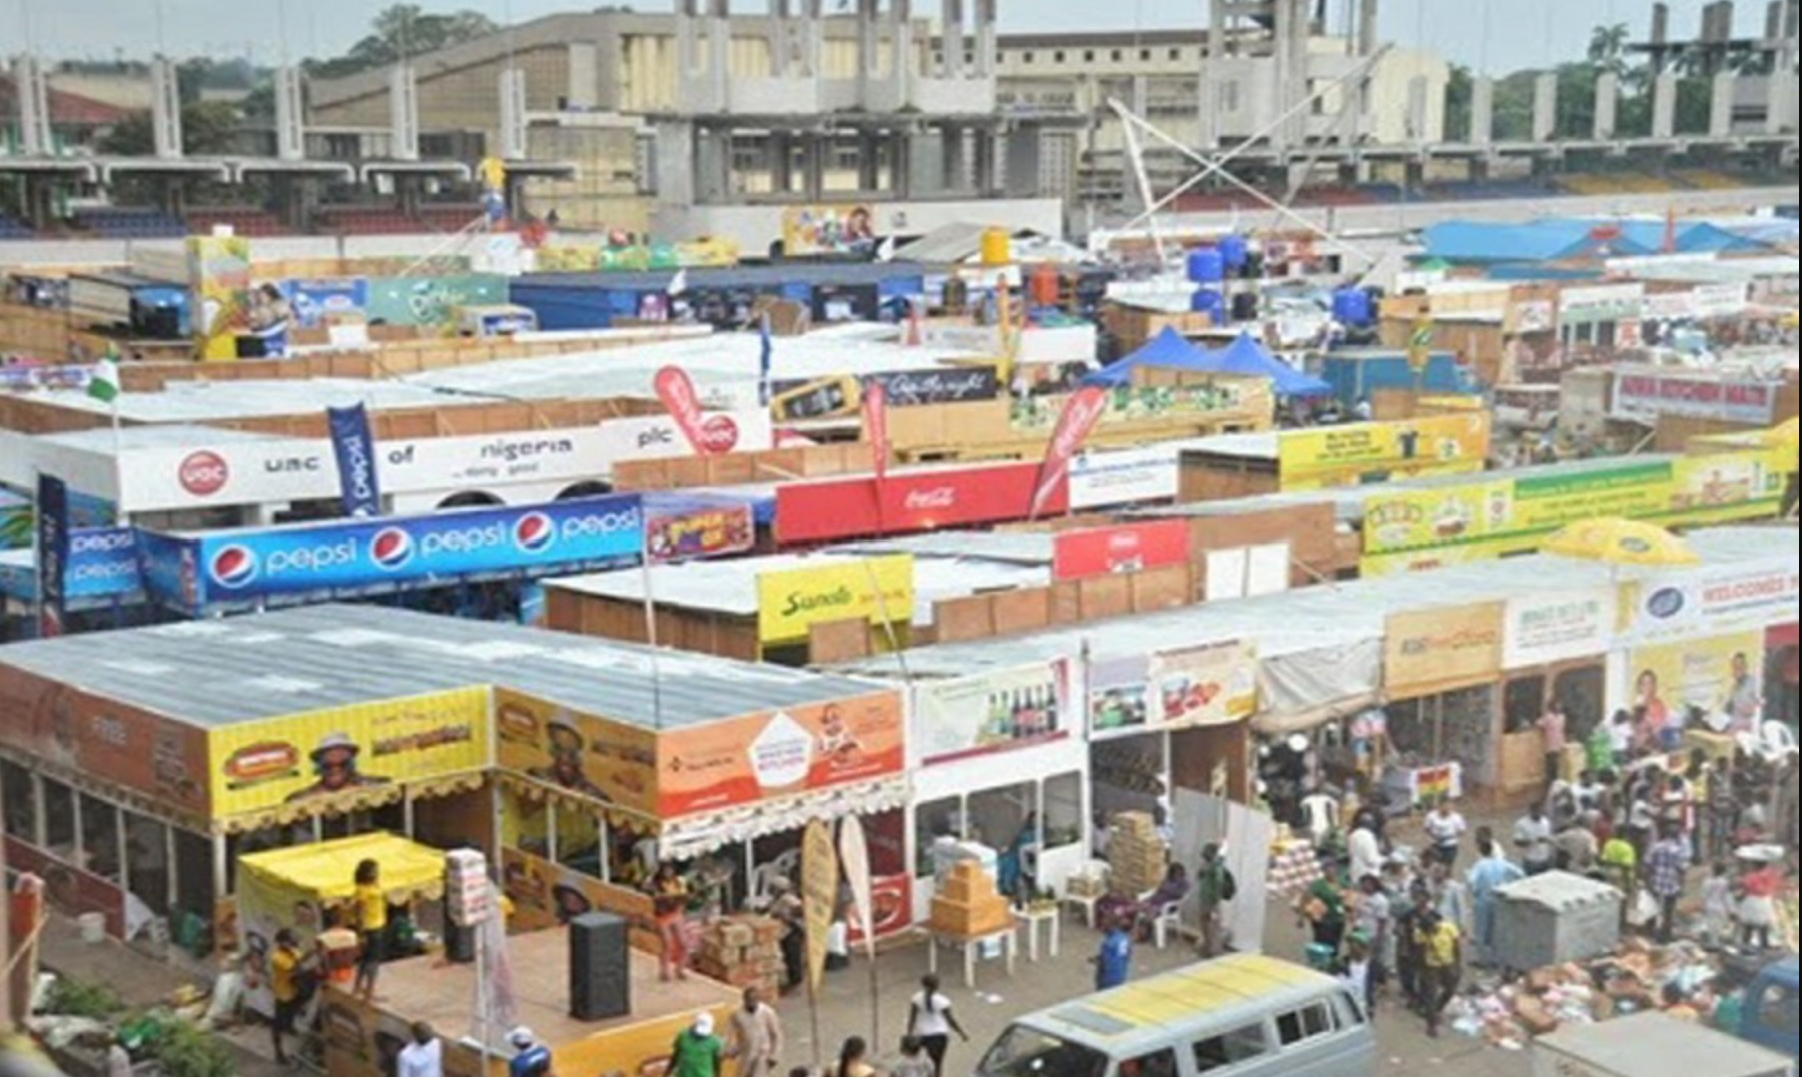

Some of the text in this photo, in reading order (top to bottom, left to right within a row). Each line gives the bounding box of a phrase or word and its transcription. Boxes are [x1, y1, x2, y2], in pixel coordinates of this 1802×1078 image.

[388, 444, 415, 465] of
[480, 436, 574, 463] nigeria
[637, 425, 674, 449] plc
[71, 530, 135, 551] pepsi
[266, 506, 640, 575] pepsi pepsi pepsi
[74, 556, 138, 580] pepsi
